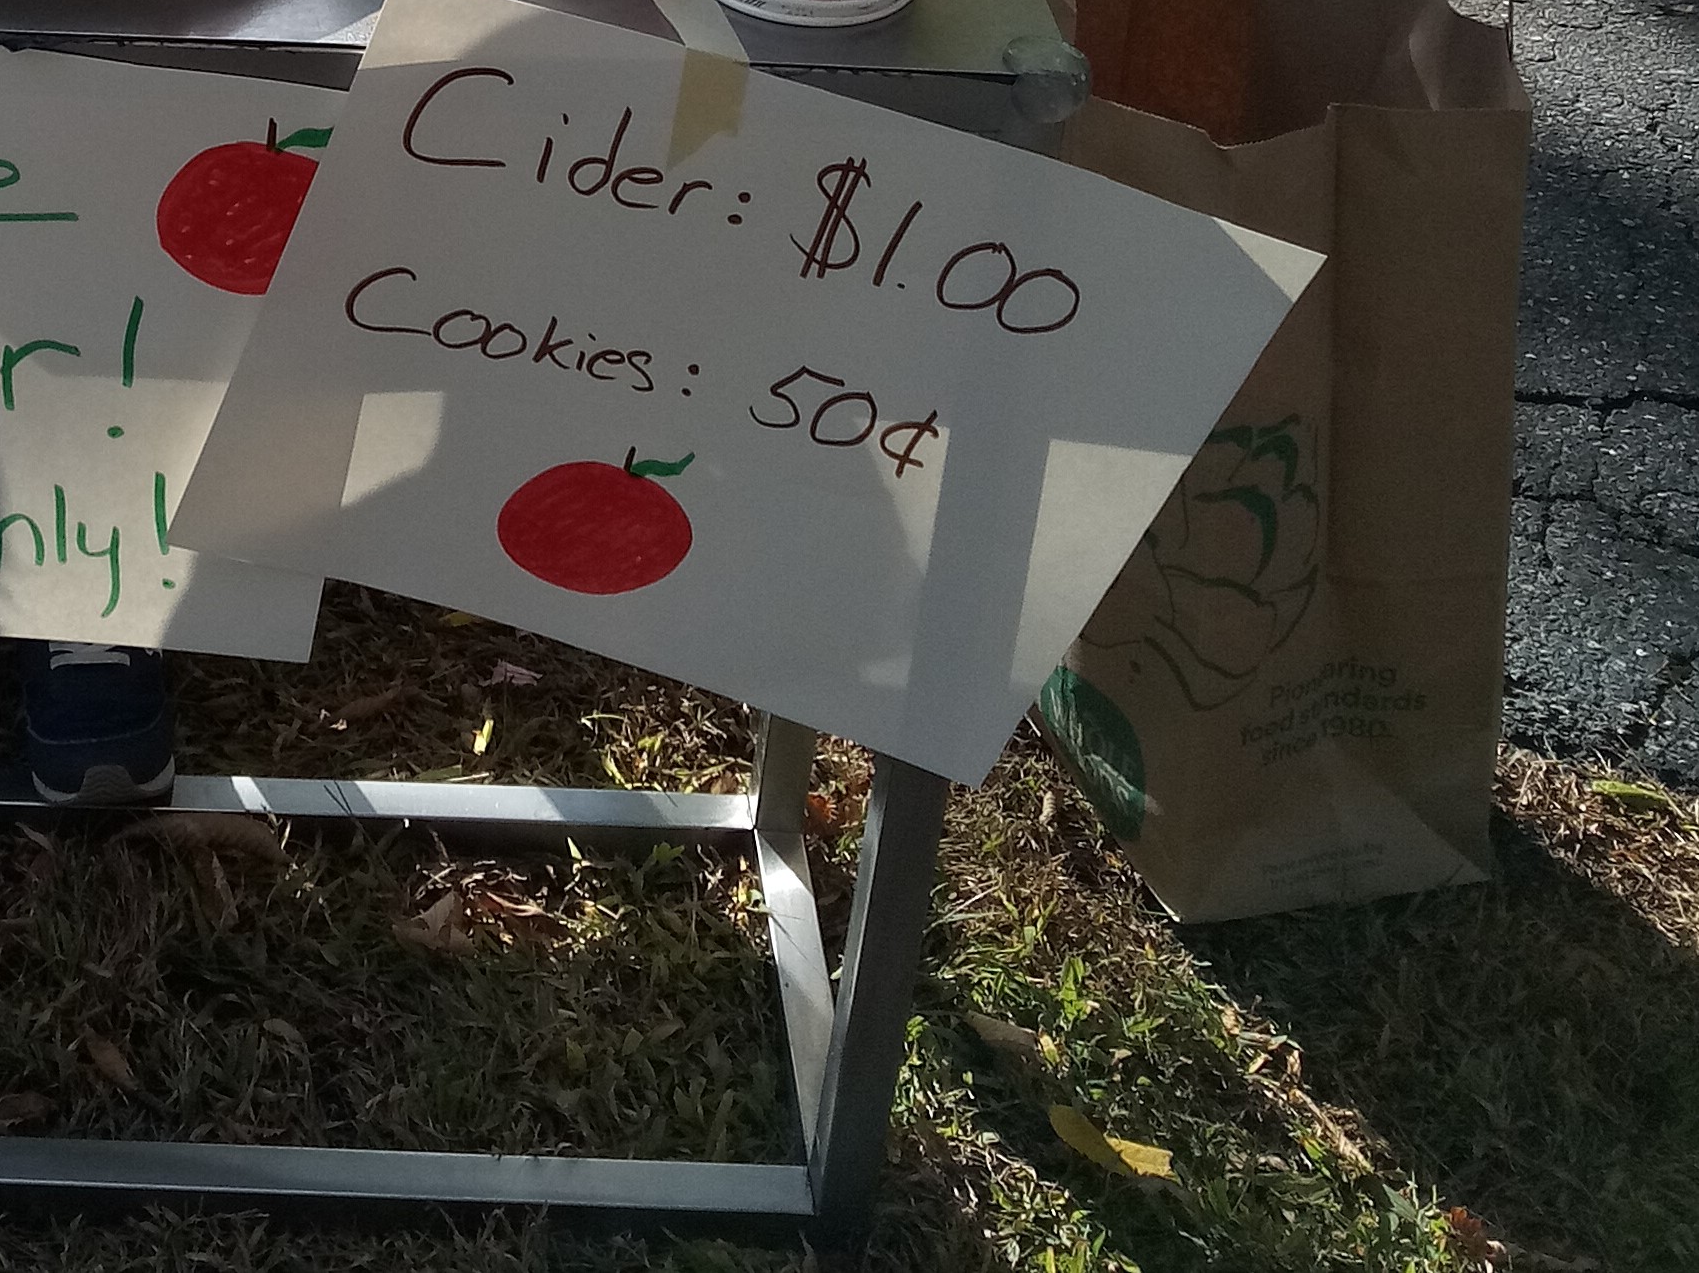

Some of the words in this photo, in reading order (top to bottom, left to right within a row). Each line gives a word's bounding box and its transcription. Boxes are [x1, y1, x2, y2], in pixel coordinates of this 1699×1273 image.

[402, 66, 753, 226] Cider:
[789, 156, 1082, 335] $1.00
[343, 266, 701, 398] Cookies:
[748, 365, 941, 480] 50¢
